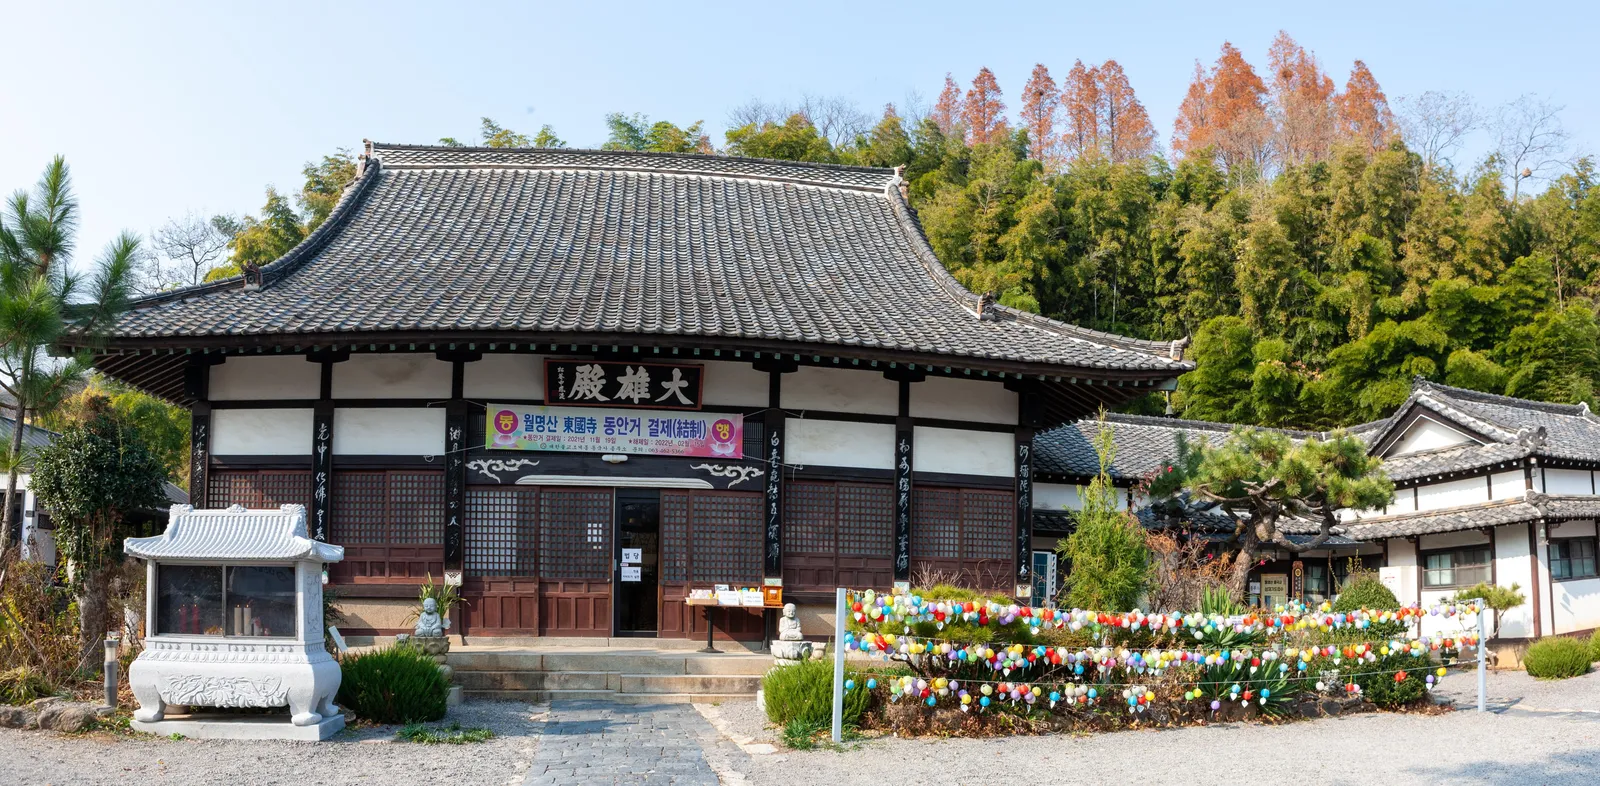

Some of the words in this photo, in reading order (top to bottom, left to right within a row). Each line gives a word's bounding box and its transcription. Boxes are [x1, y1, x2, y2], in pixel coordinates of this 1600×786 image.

[568, 364, 694, 404] 大雄殿
[500, 415, 513, 430] 봉
[524, 414, 558, 433] 월명산
[563, 416, 597, 434] 東國寺
[604, 416, 640, 436] 동안거
[648, 418, 706, 439] 결제(結制)
[716, 423, 729, 440] 행
